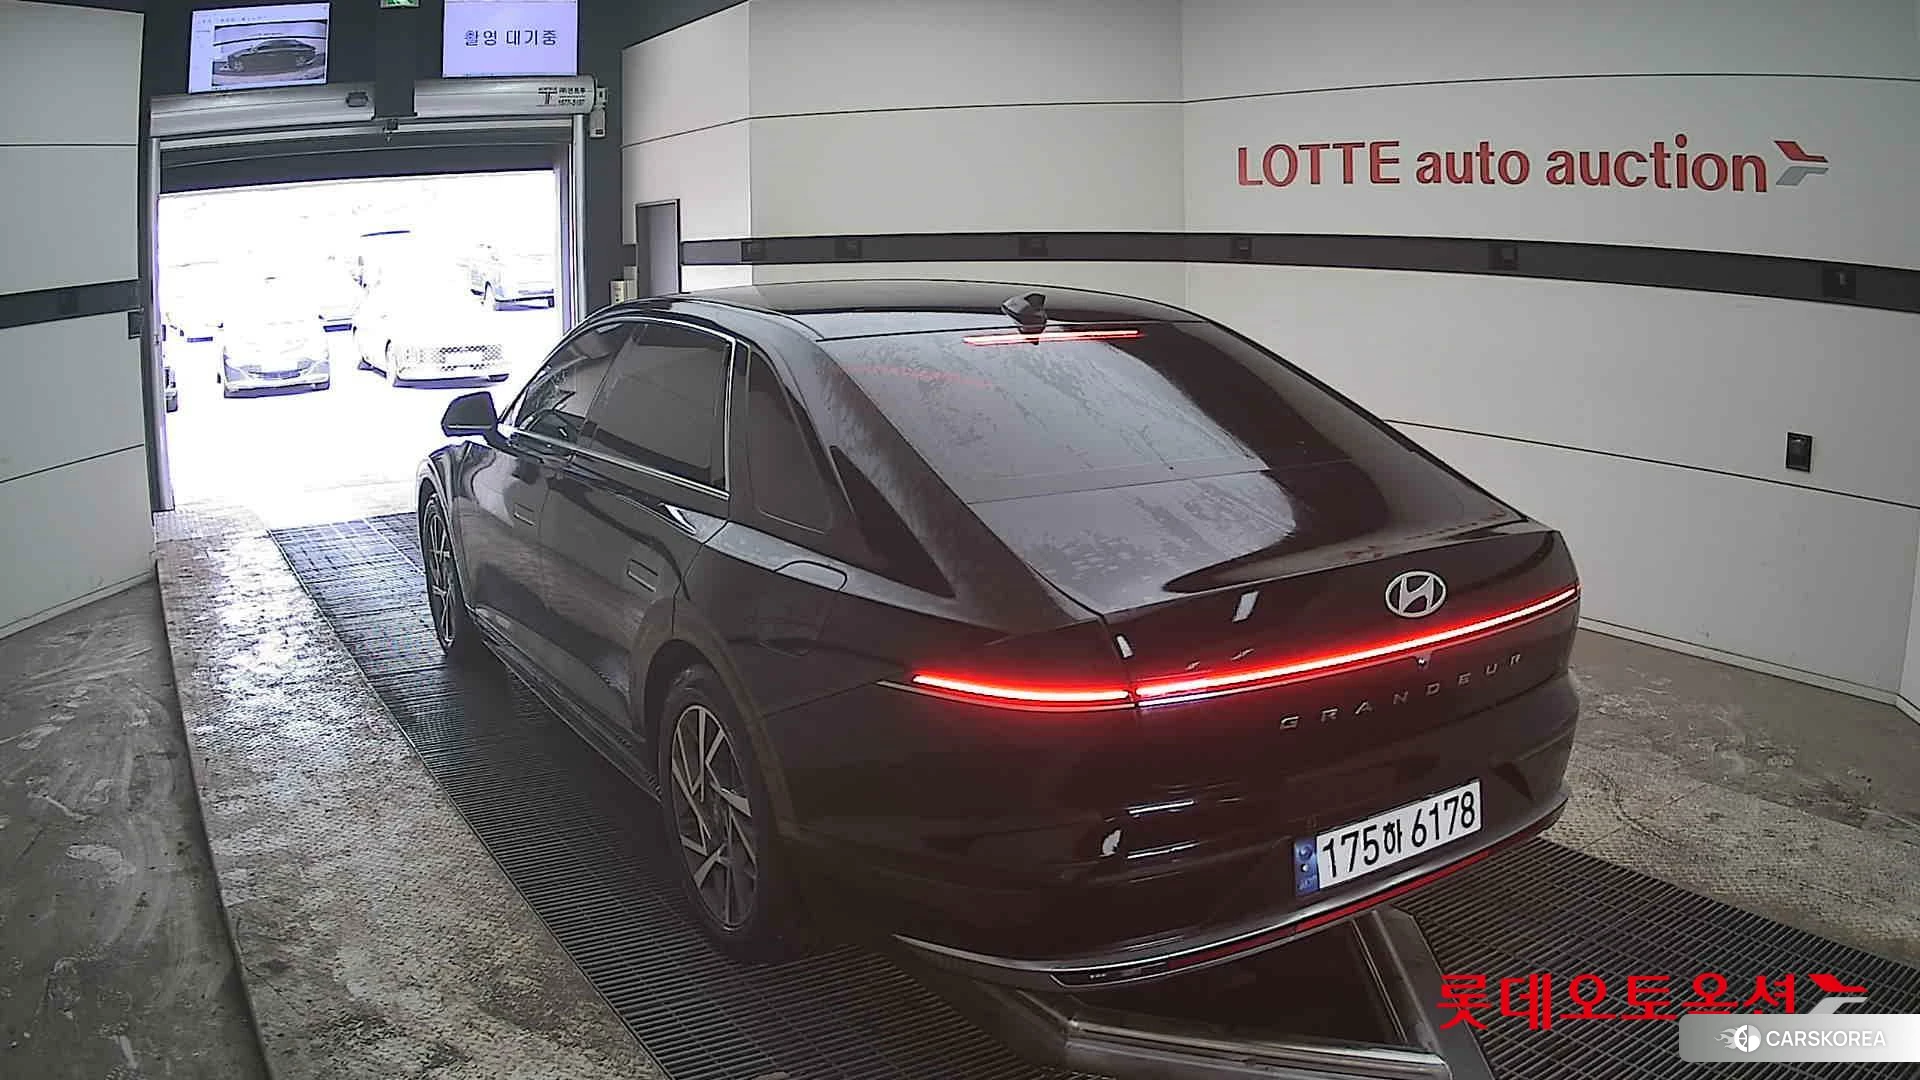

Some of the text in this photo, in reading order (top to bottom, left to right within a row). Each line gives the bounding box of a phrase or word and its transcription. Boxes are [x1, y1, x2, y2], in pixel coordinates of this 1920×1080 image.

[506, 30, 557, 46] 대기중
[1237, 133, 1767, 193] LOTTE auto auction
[1279, 653, 1521, 730] GRANDEUR
[1411, 791, 1476, 848] 6178
